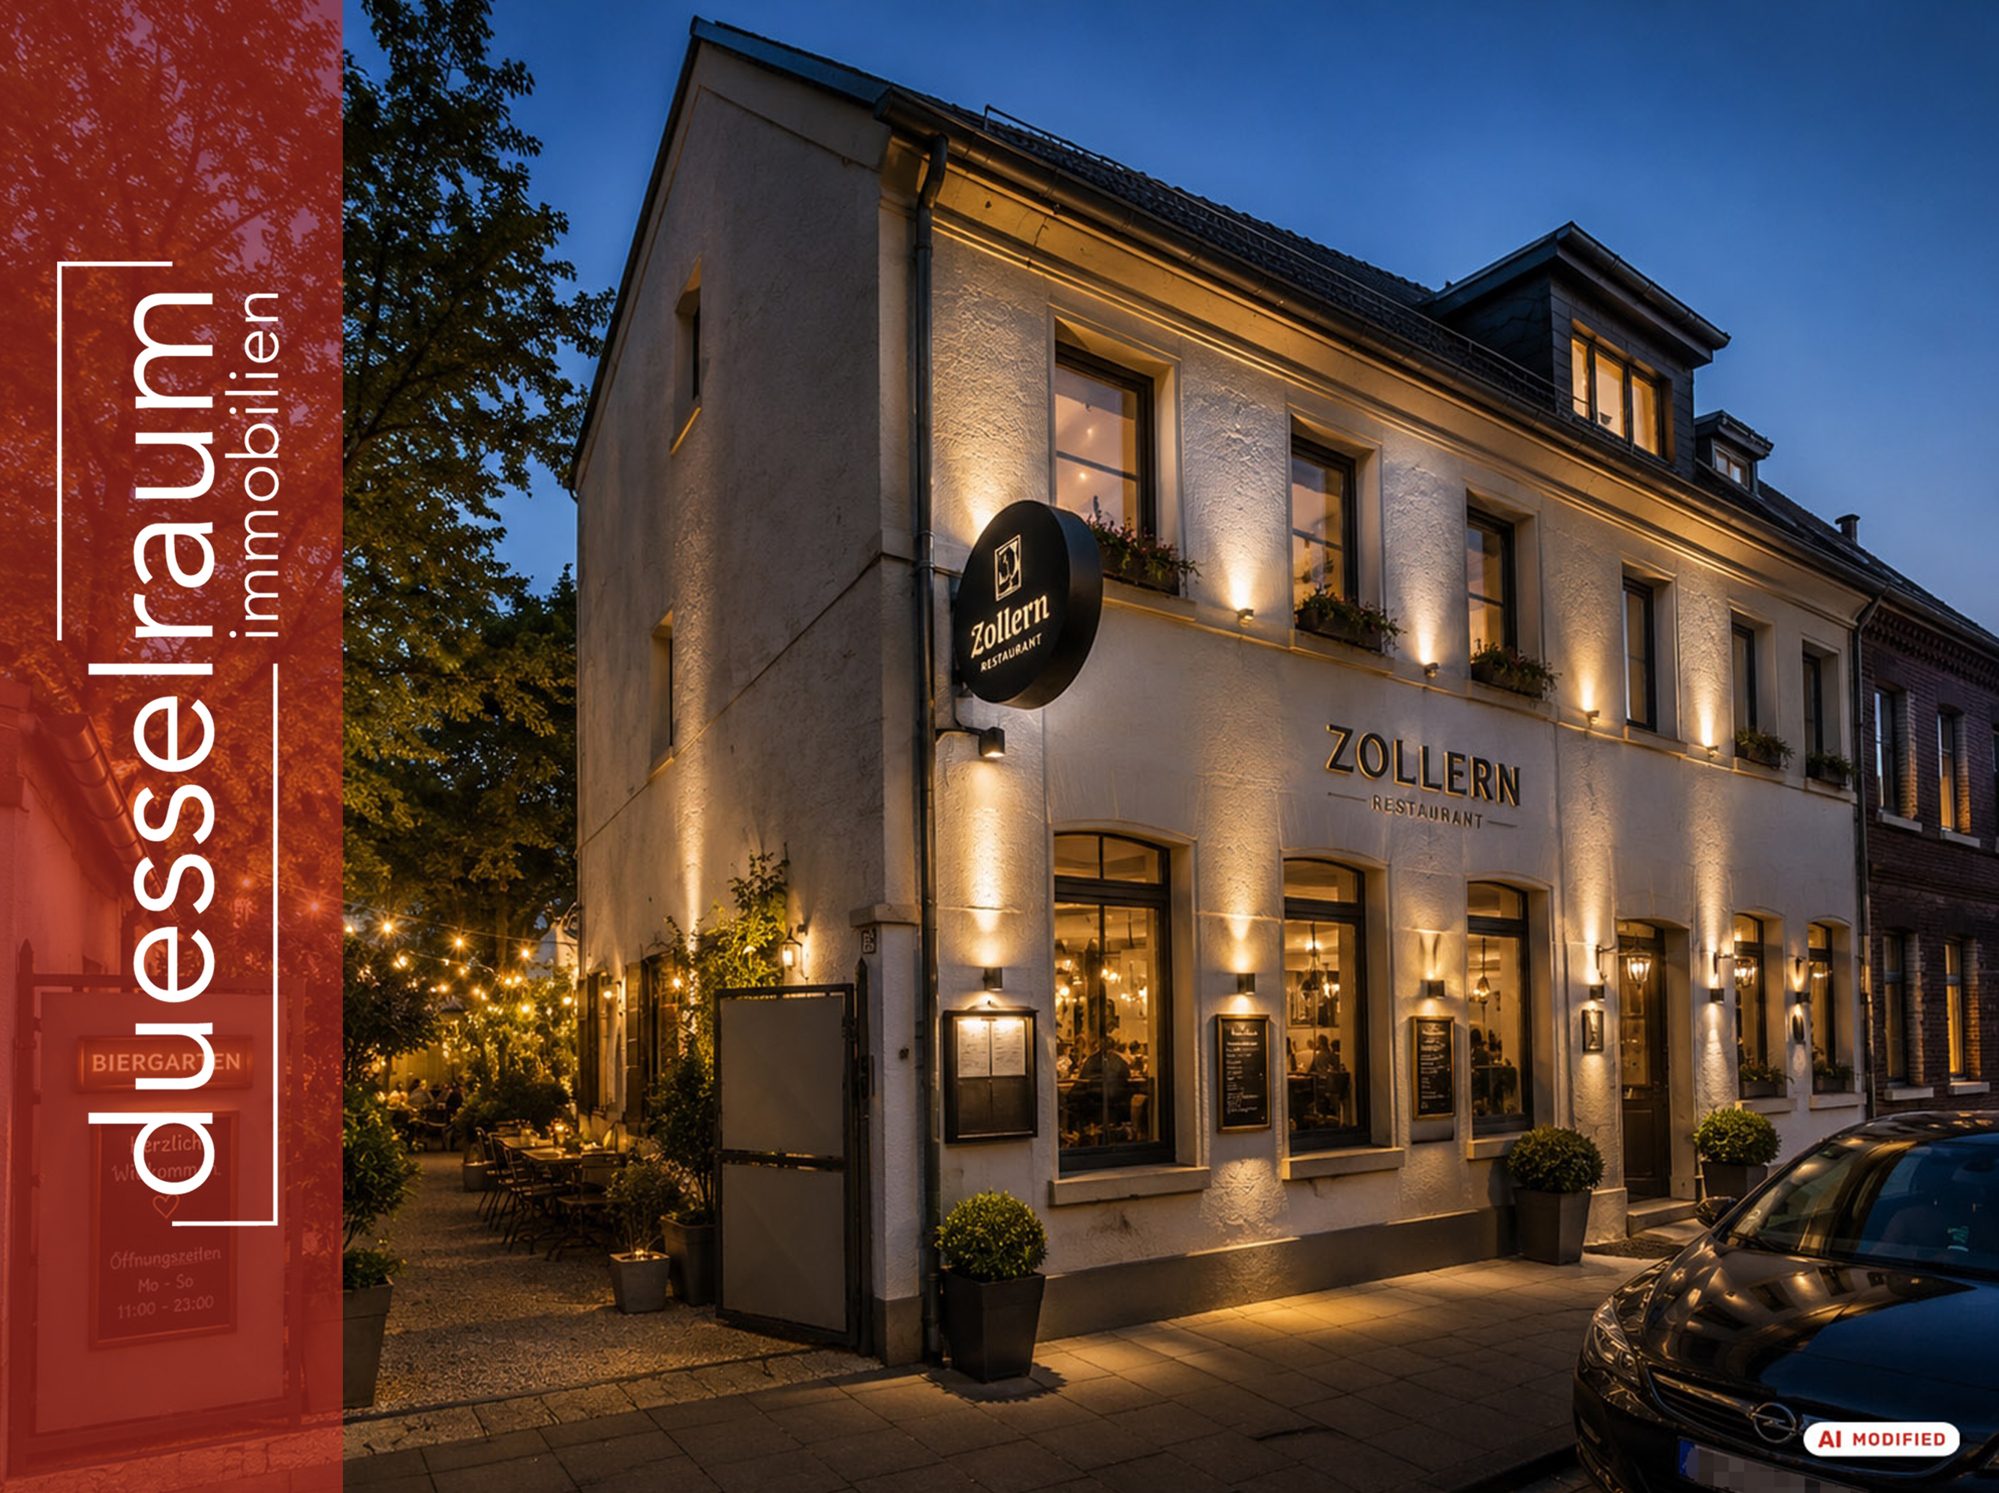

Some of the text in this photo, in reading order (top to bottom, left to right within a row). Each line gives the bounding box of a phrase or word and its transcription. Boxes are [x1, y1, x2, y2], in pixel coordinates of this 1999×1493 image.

[971, 594, 1050, 659] Zollern
[980, 633, 1043, 672] RESTAURANT
[1325, 724, 1521, 807] ZOLLERN
[1371, 794, 1483, 829] RESTAURANT
[137, 1277, 159, 1293] Mo
[175, 1273, 194, 1289] So
[117, 1300, 156, 1320] 11:00
[173, 1294, 215, 1313] 23:00
